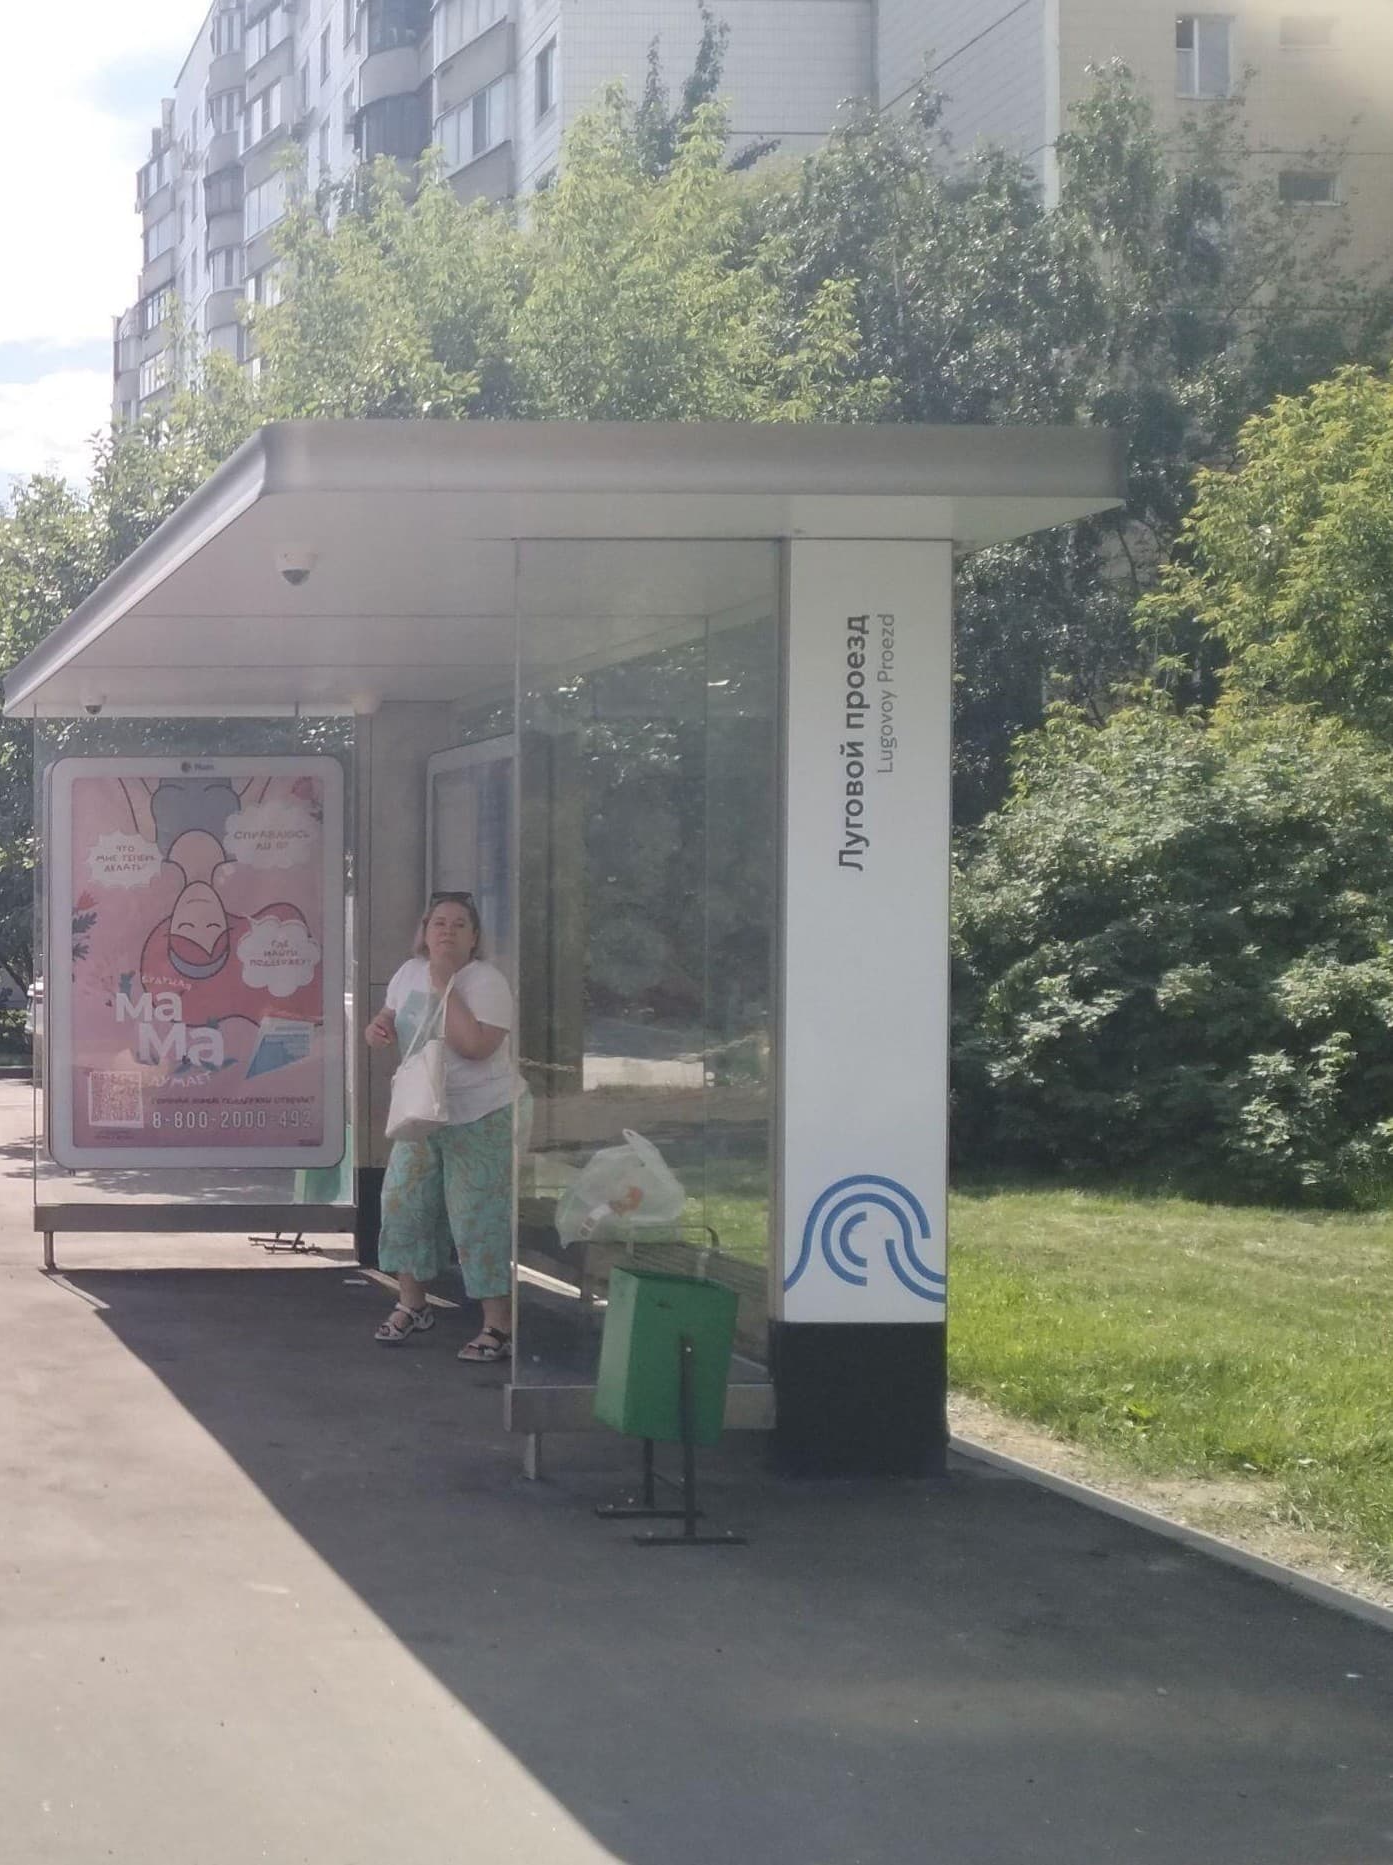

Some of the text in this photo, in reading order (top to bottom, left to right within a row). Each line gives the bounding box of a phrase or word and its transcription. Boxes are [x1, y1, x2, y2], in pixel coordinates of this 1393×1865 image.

[839, 615, 870, 871] Луговой проезд
[877, 613, 898, 773] Lugovoy Proezd
